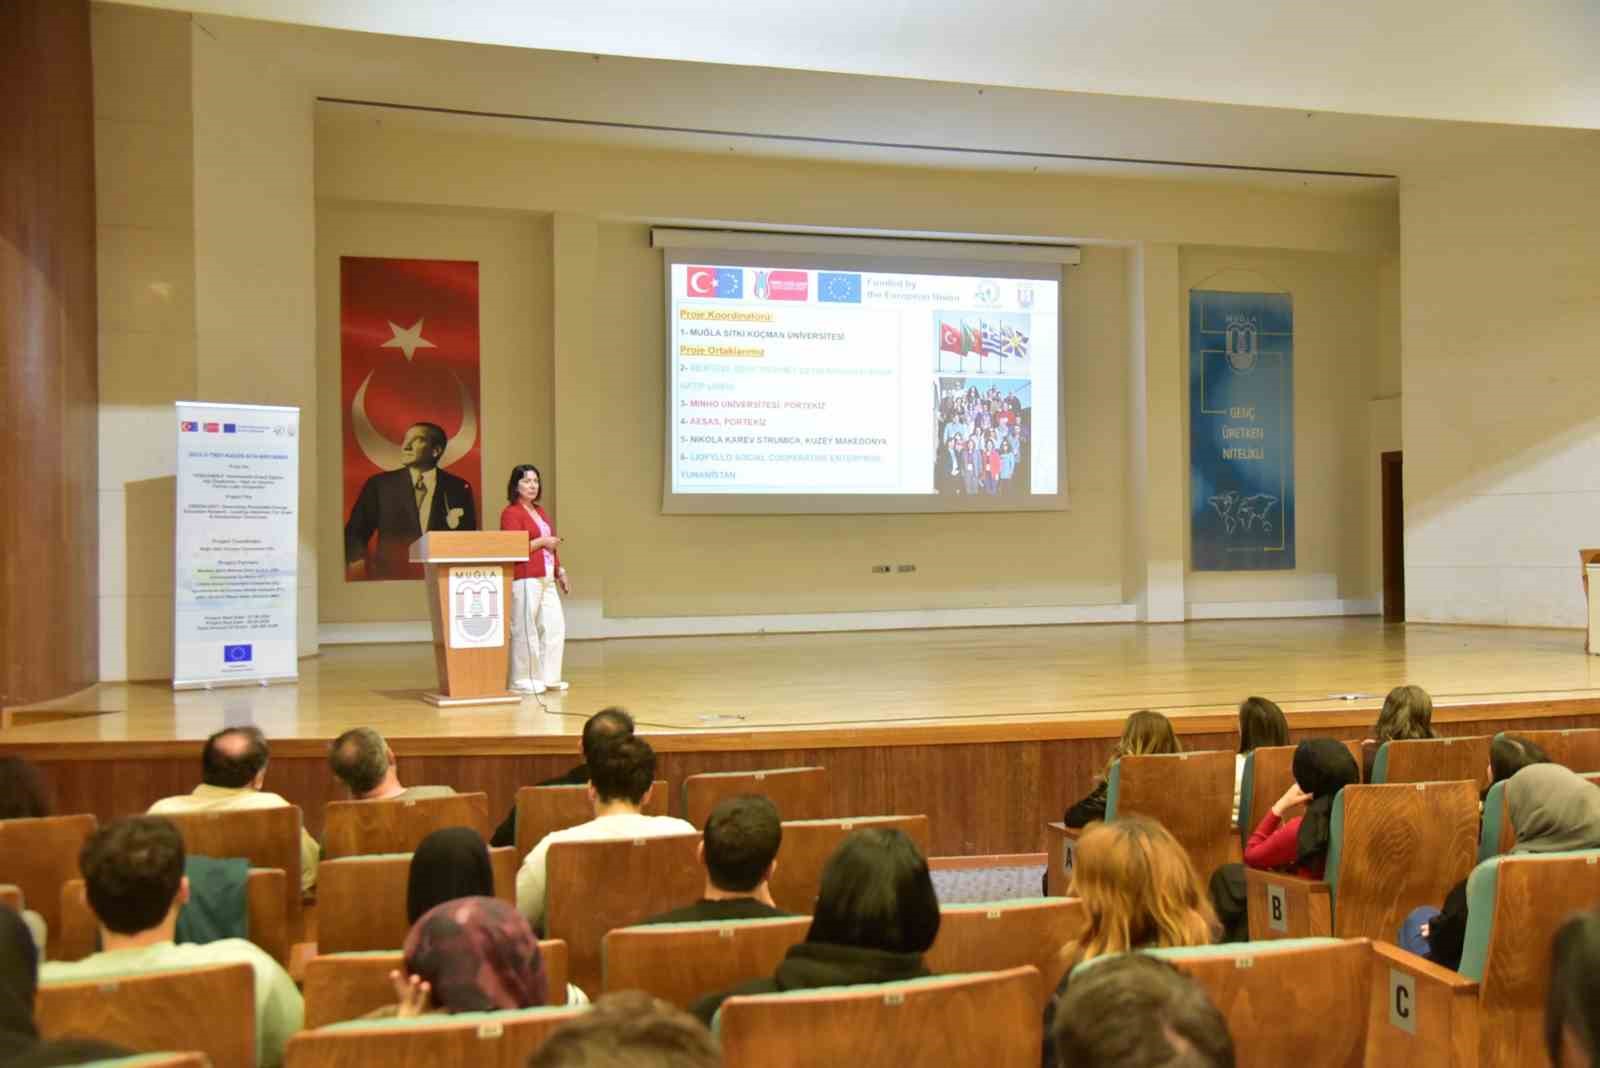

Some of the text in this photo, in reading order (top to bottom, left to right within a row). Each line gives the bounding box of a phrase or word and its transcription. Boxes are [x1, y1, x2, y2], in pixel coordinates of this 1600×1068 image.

[690, 328, 722, 337] MUĞLA
[455, 570, 497, 578] MUĞLA
[1271, 895, 1282, 920] B
[1396, 984, 1409, 1018] C
